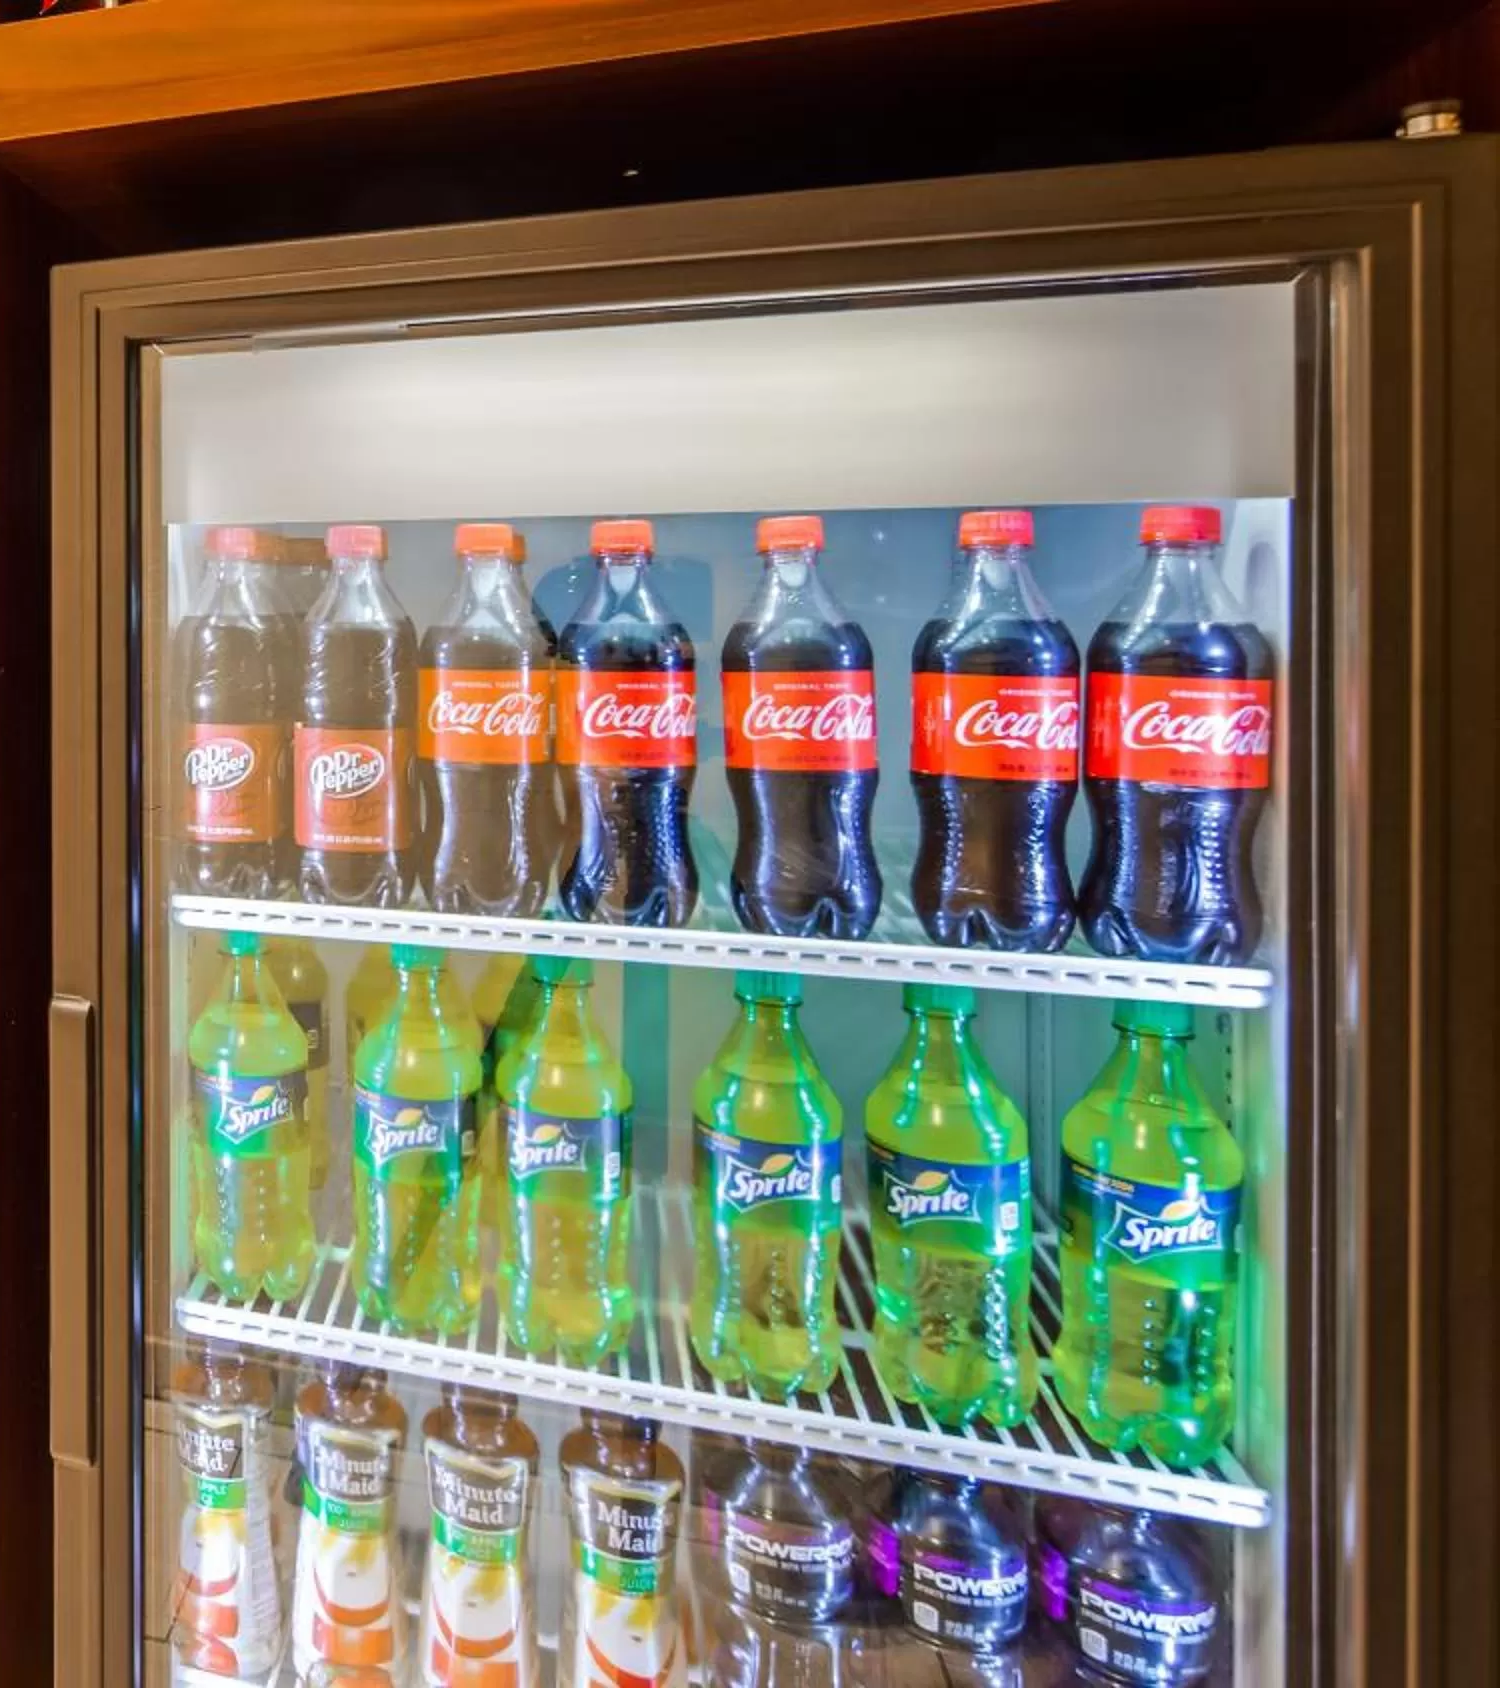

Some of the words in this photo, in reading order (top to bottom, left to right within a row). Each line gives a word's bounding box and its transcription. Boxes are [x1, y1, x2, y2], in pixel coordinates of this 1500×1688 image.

[428, 690, 545, 737] Coca-Cola
[742, 692, 873, 741] Coca-Cola
[954, 699, 1078, 751] Coca-Col
[187, 748, 249, 786] Pepper
[205, 744, 233, 765] Dr
[334, 749, 362, 772] Dr
[310, 756, 380, 793] Pepper
[224, 1097, 289, 1134] Sprite
[371, 1120, 438, 1151] Sprite
[510, 1140, 578, 1170] Sprite
[730, 1169, 812, 1201] Sprite
[886, 1184, 969, 1219] Sprite
[1118, 1215, 1218, 1251] Sprite
[435, 1464, 519, 1504] Minute
[444, 1489, 504, 1526] Maid
